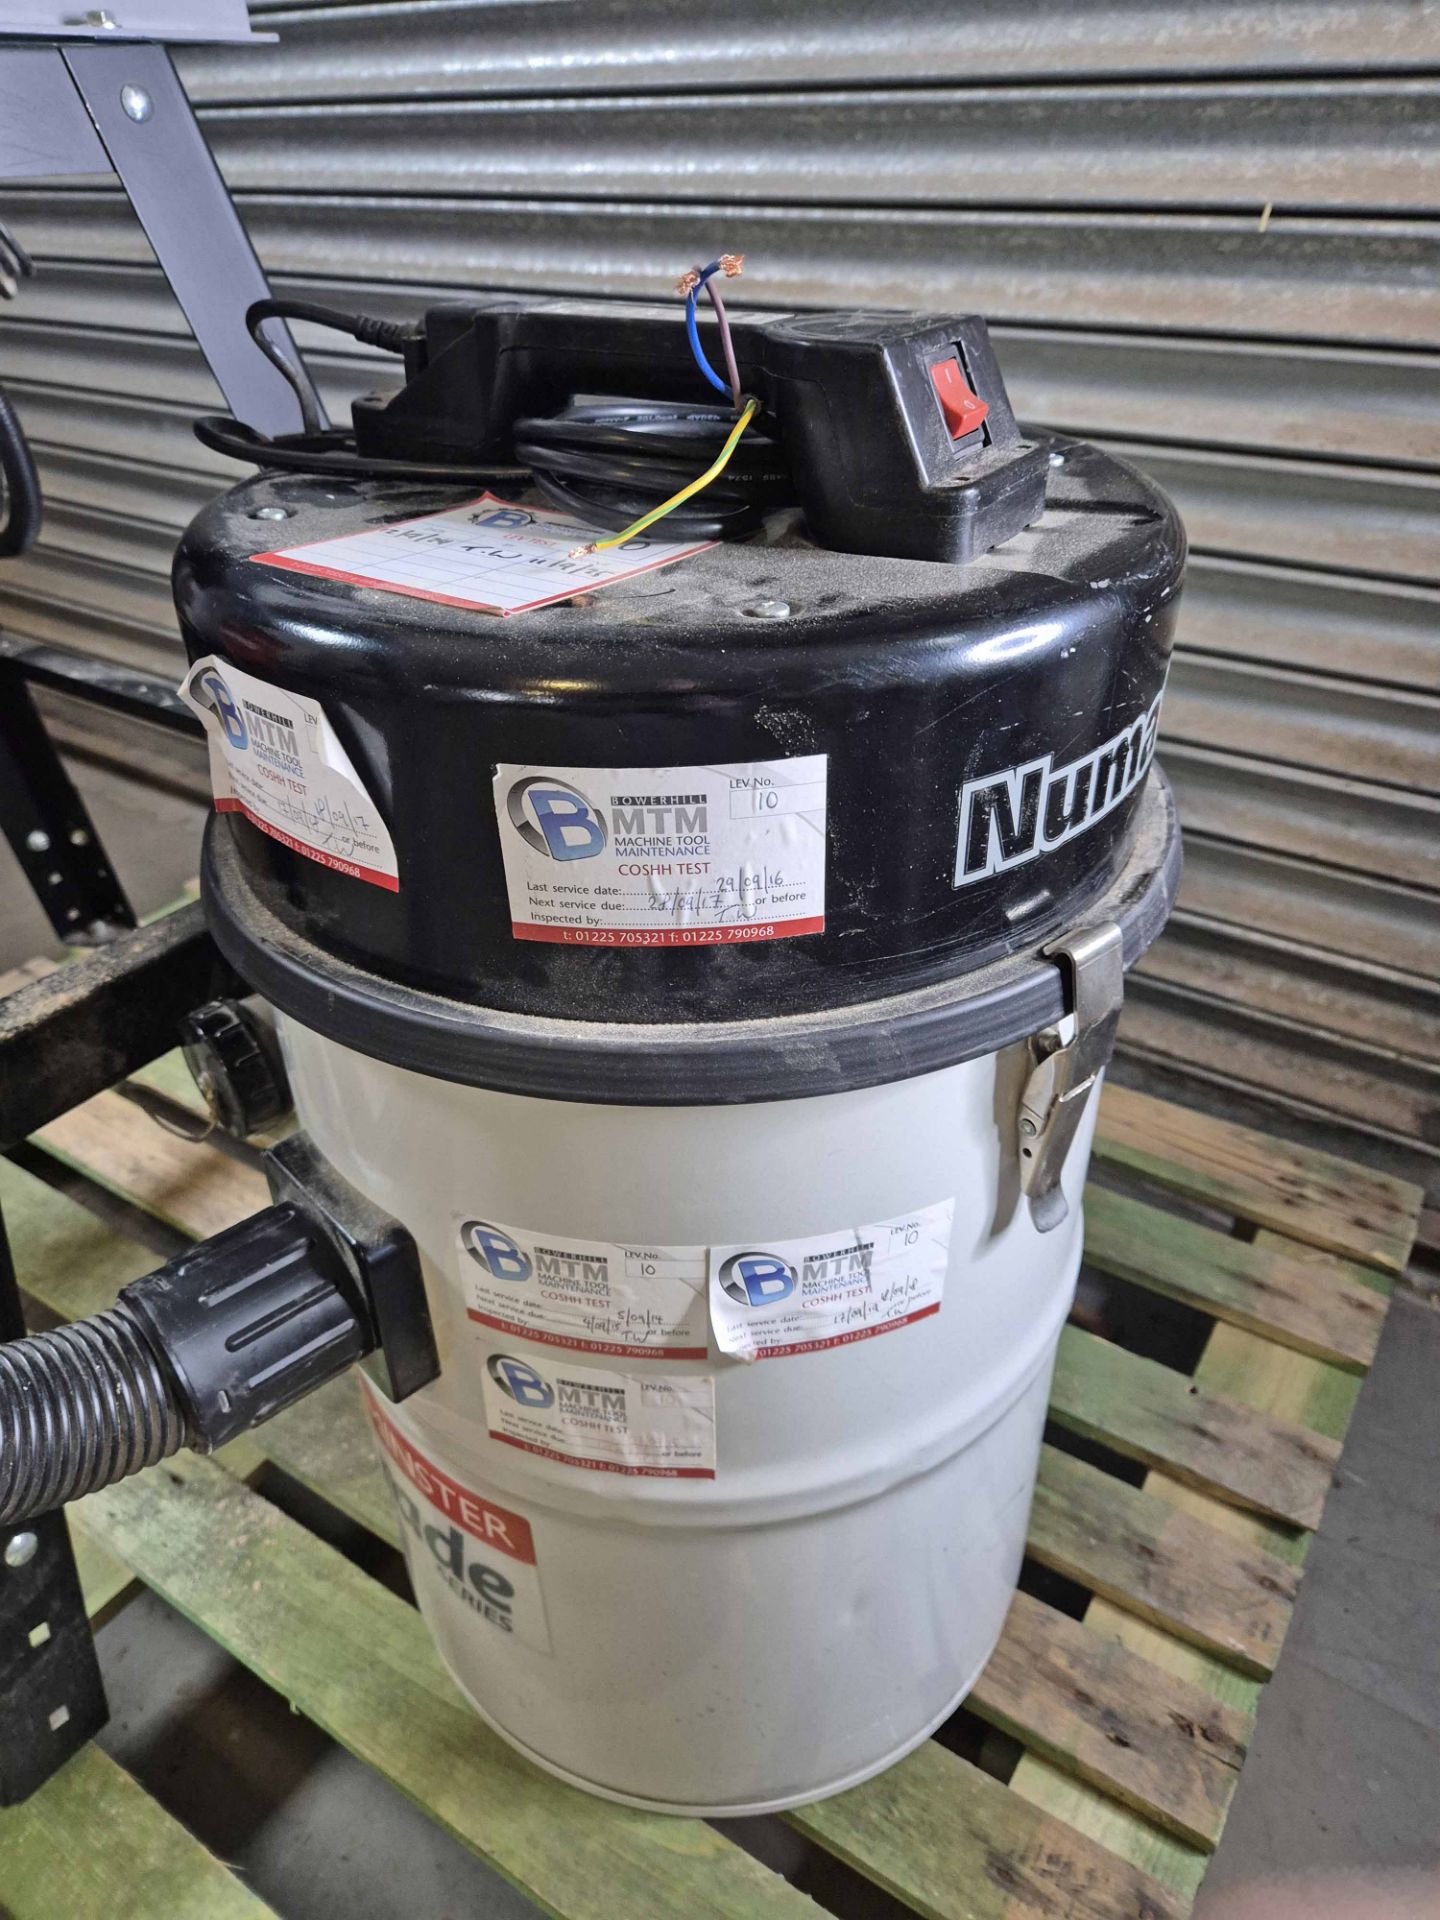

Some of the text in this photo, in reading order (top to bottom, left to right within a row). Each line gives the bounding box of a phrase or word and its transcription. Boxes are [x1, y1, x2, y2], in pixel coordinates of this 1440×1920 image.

[245, 710, 299, 757] MTM
[281, 751, 304, 769] TOOL
[257, 764, 286, 787] COSHH
[286, 778, 307, 796] TEST
[729, 777, 774, 788] LEV No.
[610, 794, 708, 806] BOWERHILL
[758, 791, 779, 811] 10
[611, 807, 708, 835] MTM
[353, 838, 381, 854] before
[614, 835, 710, 847] MACHINE TOOL
[615, 846, 711, 857] MAINTENANCE
[301, 846, 326, 864] 01225
[327, 856, 361, 877] 790968
[618, 862, 711, 876] COSHH TEST
[527, 881, 621, 896] Last service date:
[529, 896, 625, 911] Next service due:
[755, 891, 806, 905] or before
[530, 911, 602, 927] Inspected by:
[575, 932, 615, 943] 01225
[619, 932, 665, 945] 705321
[682, 930, 722, 942] 01225
[727, 925, 774, 940] 790968
[904, 1230, 919, 1246] 10
[535, 1255, 609, 1282] MTM
[640, 1262, 656, 1276] 10
[802, 1250, 874, 1281] MTM
[537, 1273, 610, 1290] MACHINE TOOL
[538, 1280, 611, 1297] MAINTENANCE
[802, 1276, 844, 1289] MACHINE
[493, 1291, 519, 1303] service
[540, 1290, 612, 1309] COSHH TEST
[801, 1286, 871, 1309] COSHH TEST
[747, 1319, 777, 1328] service
[660, 1328, 690, 1337] before
[590, 1342, 623, 1353] 01225
[626, 1345, 665, 1357] 790968
[558, 1386, 626, 1411] MTM
[561, 1417, 602, 1431] COSHH
